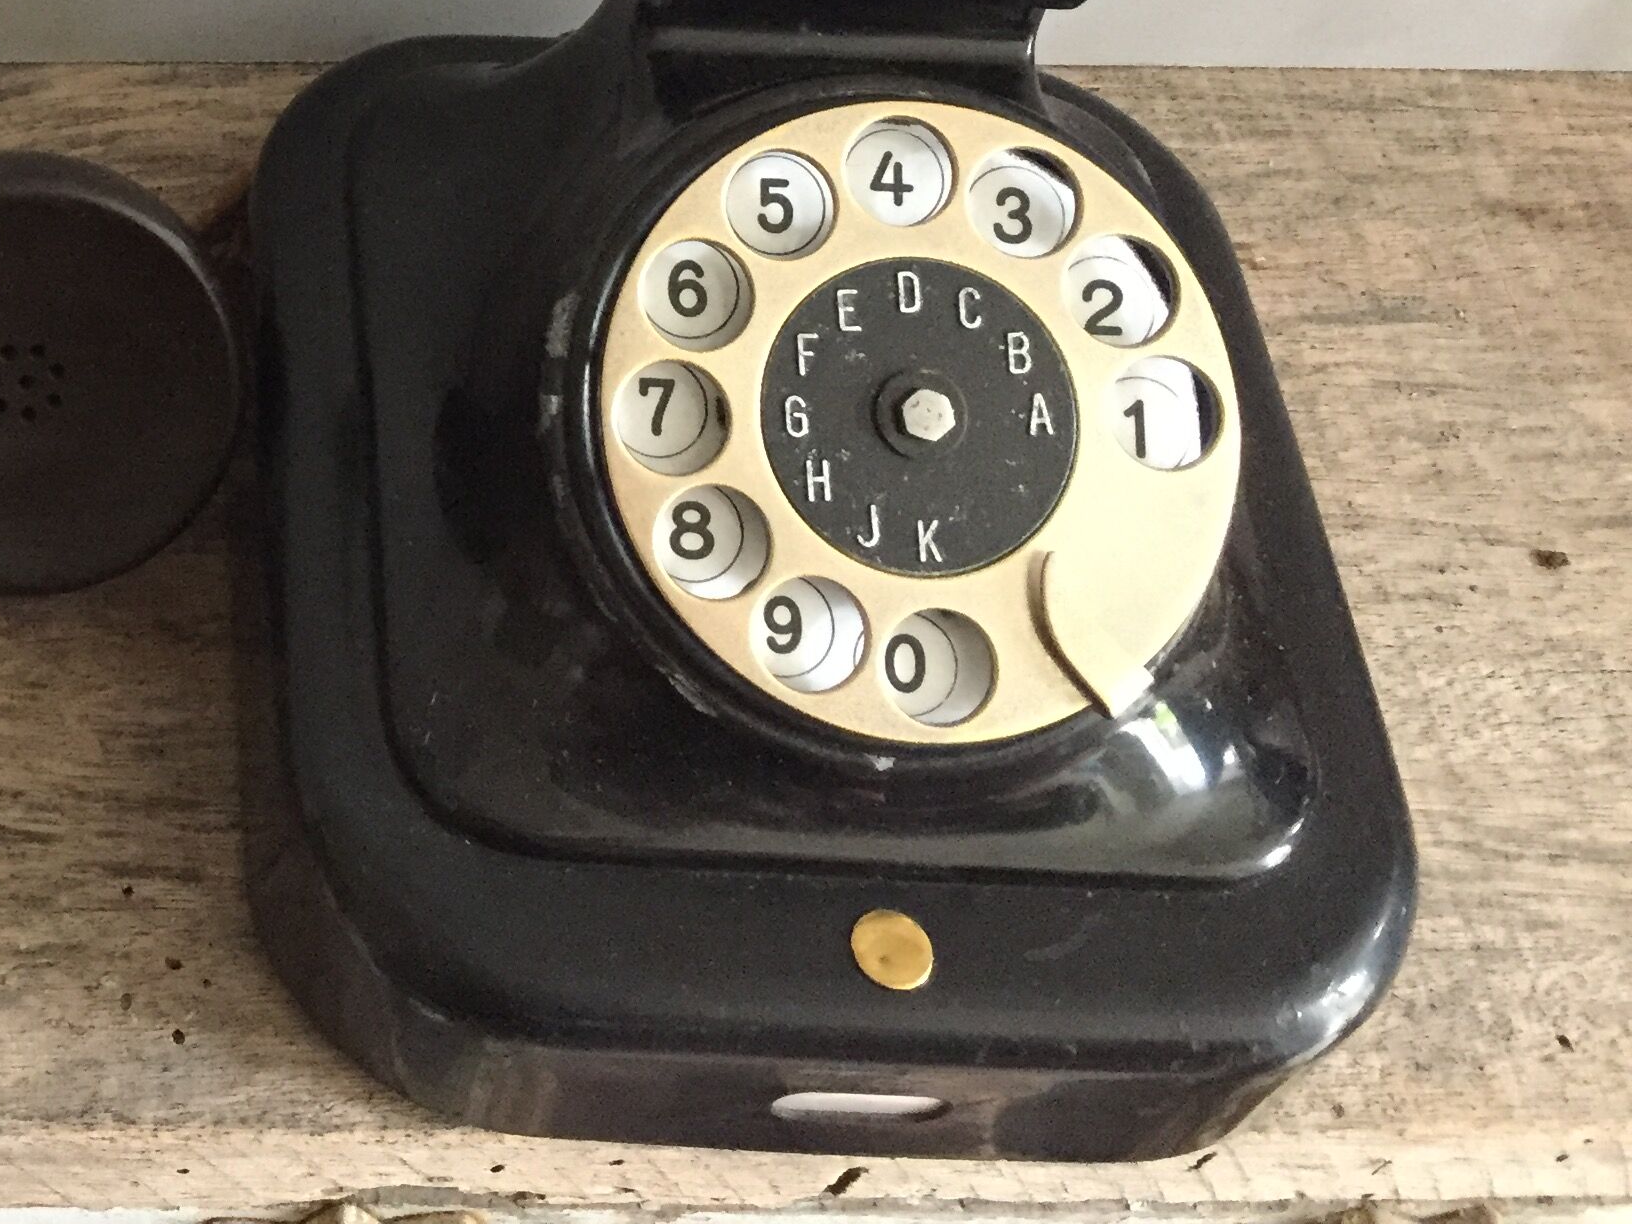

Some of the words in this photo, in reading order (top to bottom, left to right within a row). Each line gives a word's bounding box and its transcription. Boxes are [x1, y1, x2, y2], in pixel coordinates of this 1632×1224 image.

[869, 150, 915, 207] 4
[757, 177, 794, 235] 5
[993, 186, 1033, 245] 3
[667, 259, 708, 318] 6
[836, 288, 863, 332] E
[897, 270, 924, 314] D
[958, 286, 983, 330] C
[1081, 278, 1124, 337] 2
[796, 332, 820, 377] F
[1007, 331, 1033, 375] B
[638, 377, 676, 437] 7
[784, 395, 810, 438] G
[1029, 392, 1054, 436] A
[1123, 399, 1147, 459] 1
[805, 459, 832, 503] H
[669, 500, 716, 561] 8
[856, 504, 881, 548] J
[917, 519, 943, 563] K
[763, 595, 803, 655] 9
[884, 633, 926, 694] 0
